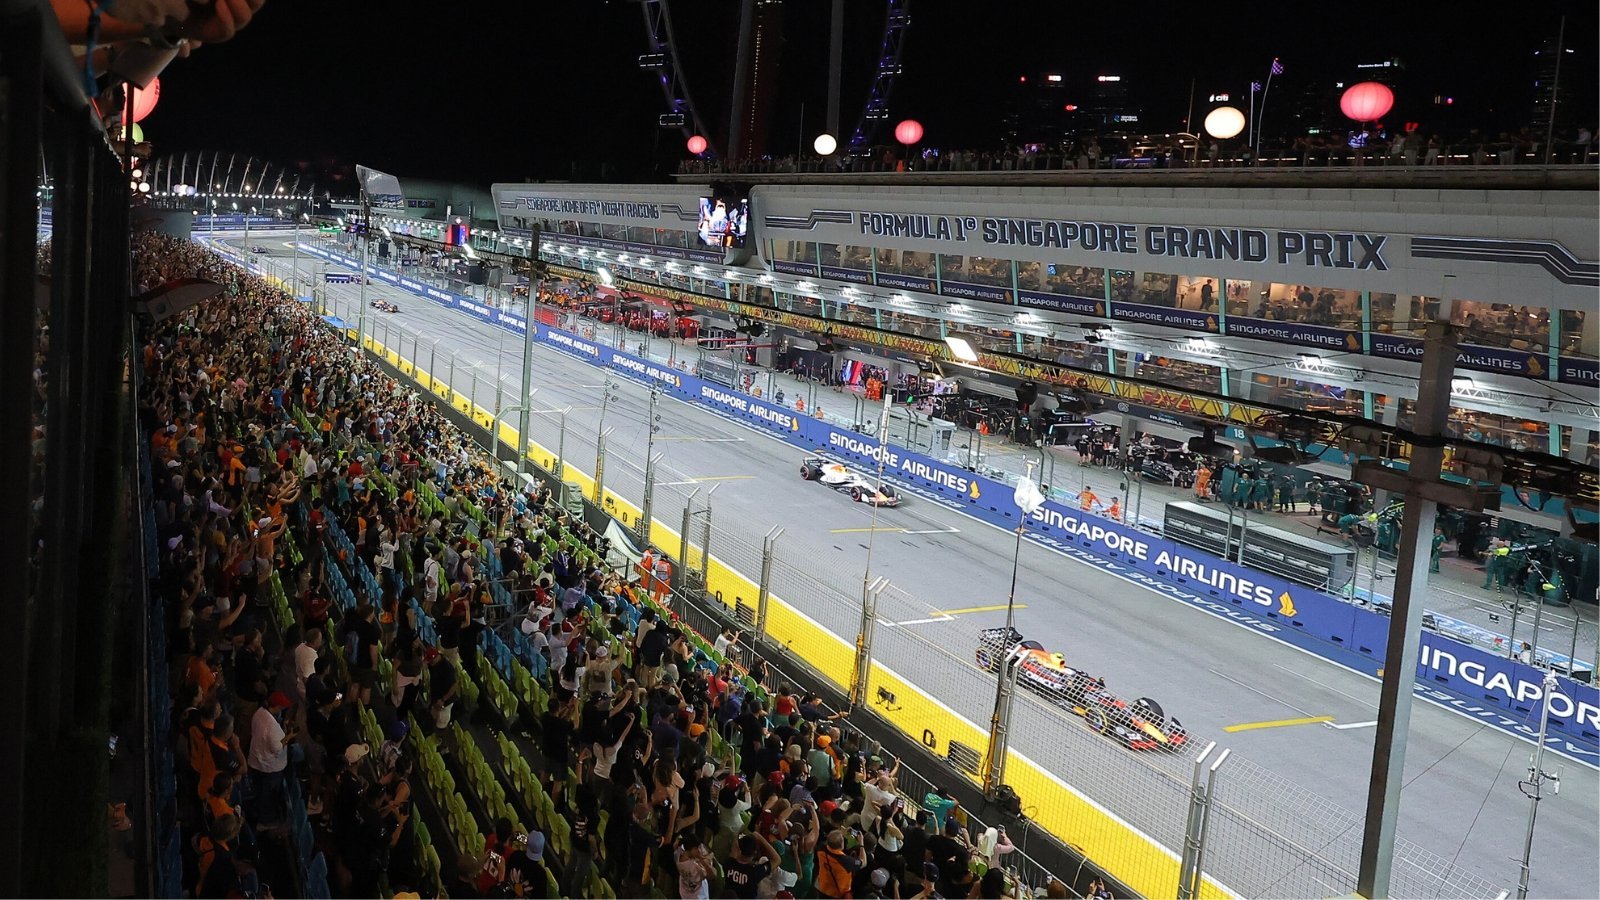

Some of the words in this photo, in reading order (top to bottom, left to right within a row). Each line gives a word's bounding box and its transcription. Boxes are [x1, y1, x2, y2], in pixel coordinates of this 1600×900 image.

[561, 200, 579, 214] HOME
[579, 200, 590, 214] OF
[602, 201, 625, 217] NIGHT
[627, 202, 660, 219] RACING
[859, 213, 951, 240] FORMULA
[982, 218, 1138, 253] SINGAPORE
[1145, 226, 1269, 263] GRAND
[1277, 231, 1389, 270] PRIX
[823, 270, 847, 279] SINGAPORE
[847, 273, 867, 282] AIRLINES
[878, 278, 906, 287] SINGAPORE
[907, 282, 930, 290] AIRLINES
[943, 286, 976, 296] SINGAPORE
[977, 291, 1004, 300] AIRLINES
[1020, 296, 1059, 308] SINGAPORE
[1061, 301, 1094, 312] AIRLINES
[1114, 308, 1162, 321] SINGAPORE
[1164, 315, 1204, 328] AIRLINES
[548, 331, 573, 346] SINGAPORE
[573, 340, 595, 355] AIRLINES
[1229, 323, 1289, 339] SINGAPORE
[1292, 332, 1343, 346] AIRLINES
[612, 354, 645, 373] SINGAPORE
[646, 364, 676, 384] AIRLINES
[1375, 343, 1424, 356] SINGAP
[1456, 353, 1522, 370] AIRLINES
[701, 386, 747, 412] SINGAPORE
[748, 404, 791, 427] AIRLINES
[1233, 428, 1245, 439] 18
[829, 432, 899, 468] SINGAPORE
[902, 459, 968, 493] AIRLINES
[1027, 532, 1121, 570] AIRLINES
[1031, 506, 1150, 561] SINGAPORE
[1154, 550, 1273, 607] AIRLINES
[1124, 570, 1281, 633] SINGAPORE
[1420, 645, 1600, 731] INGAPOR
